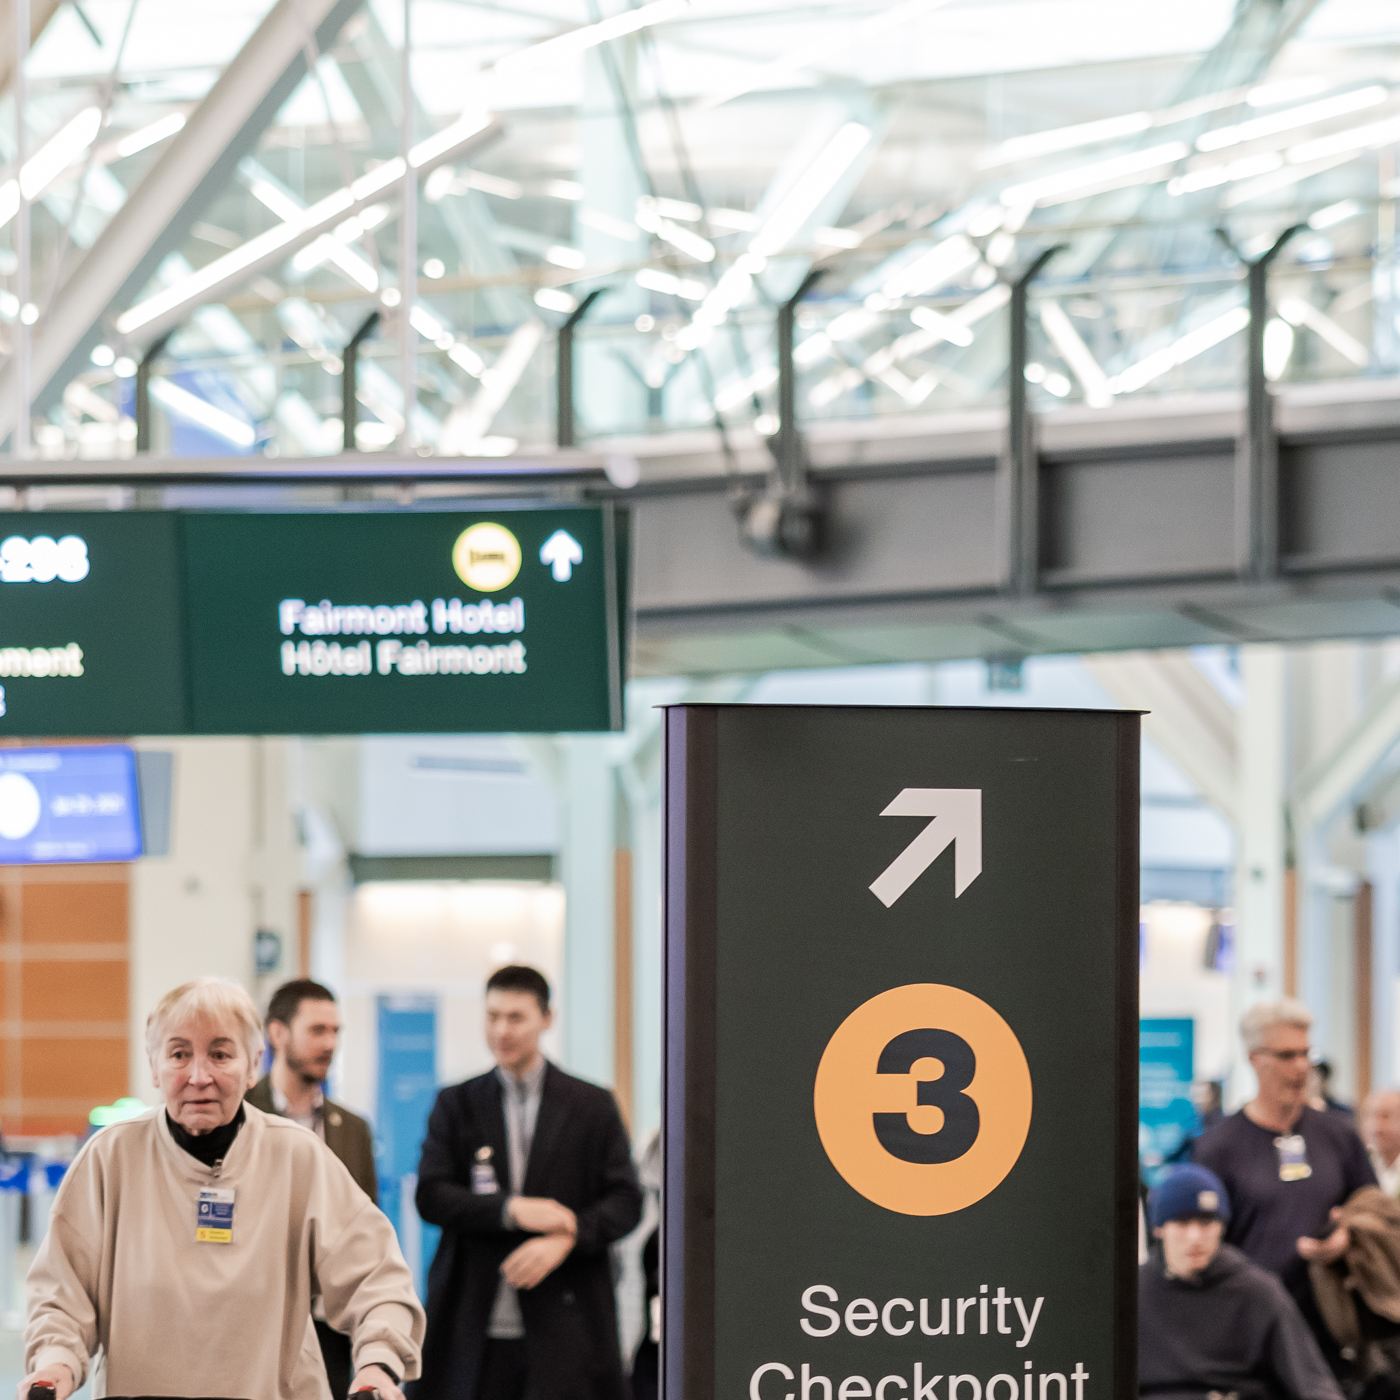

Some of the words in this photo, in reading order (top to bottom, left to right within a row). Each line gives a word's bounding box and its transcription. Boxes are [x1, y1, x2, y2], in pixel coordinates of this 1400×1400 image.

[279, 599, 429, 635] Fairmont
[432, 597, 525, 634] Hotel
[281, 639, 372, 676] Hôtel
[376, 639, 527, 676] Fairmont
[872, 1027, 981, 1165] 3
[800, 1284, 1045, 1348] Security
